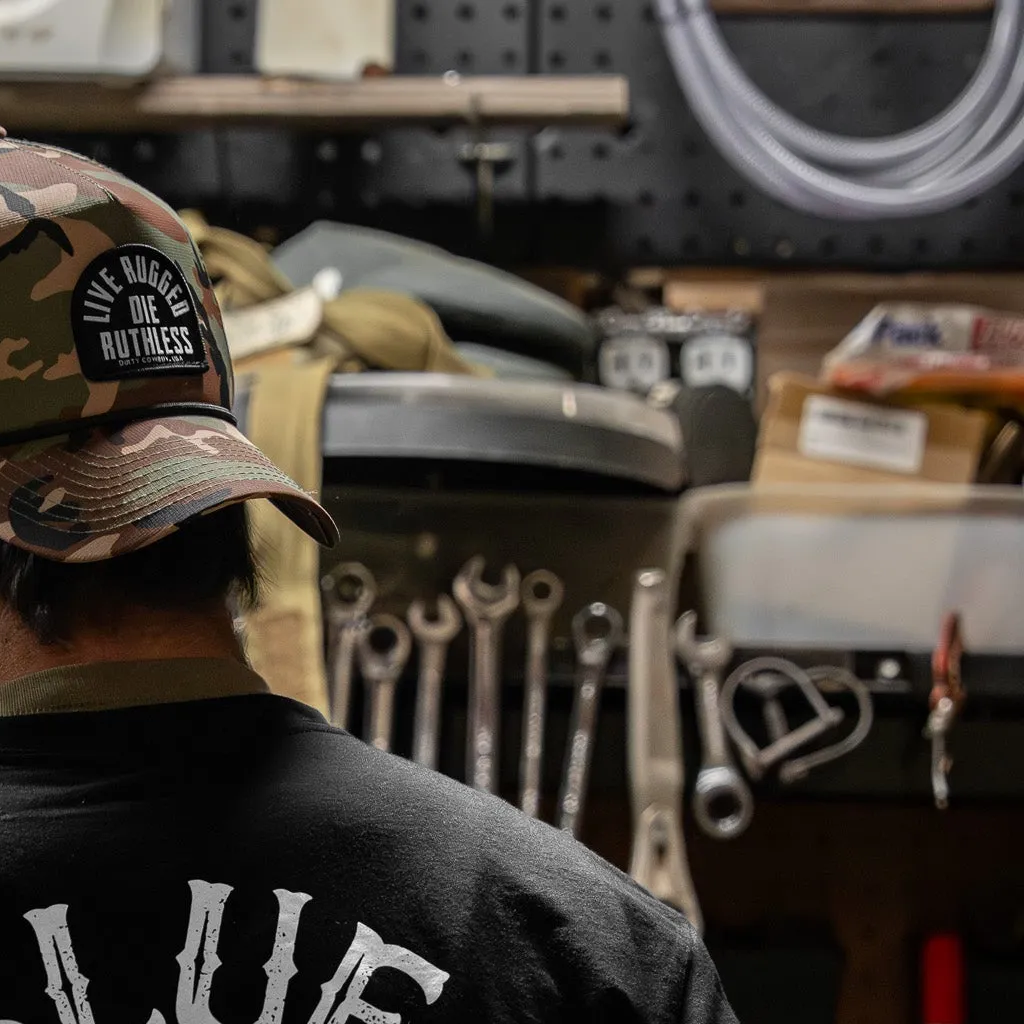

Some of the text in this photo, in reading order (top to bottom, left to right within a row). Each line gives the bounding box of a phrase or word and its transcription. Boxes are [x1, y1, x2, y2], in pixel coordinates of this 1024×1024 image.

[83, 254, 190, 323] LIVE RUGGED
[128, 295, 160, 325] DIE
[99, 326, 194, 361] RUTHLESS
